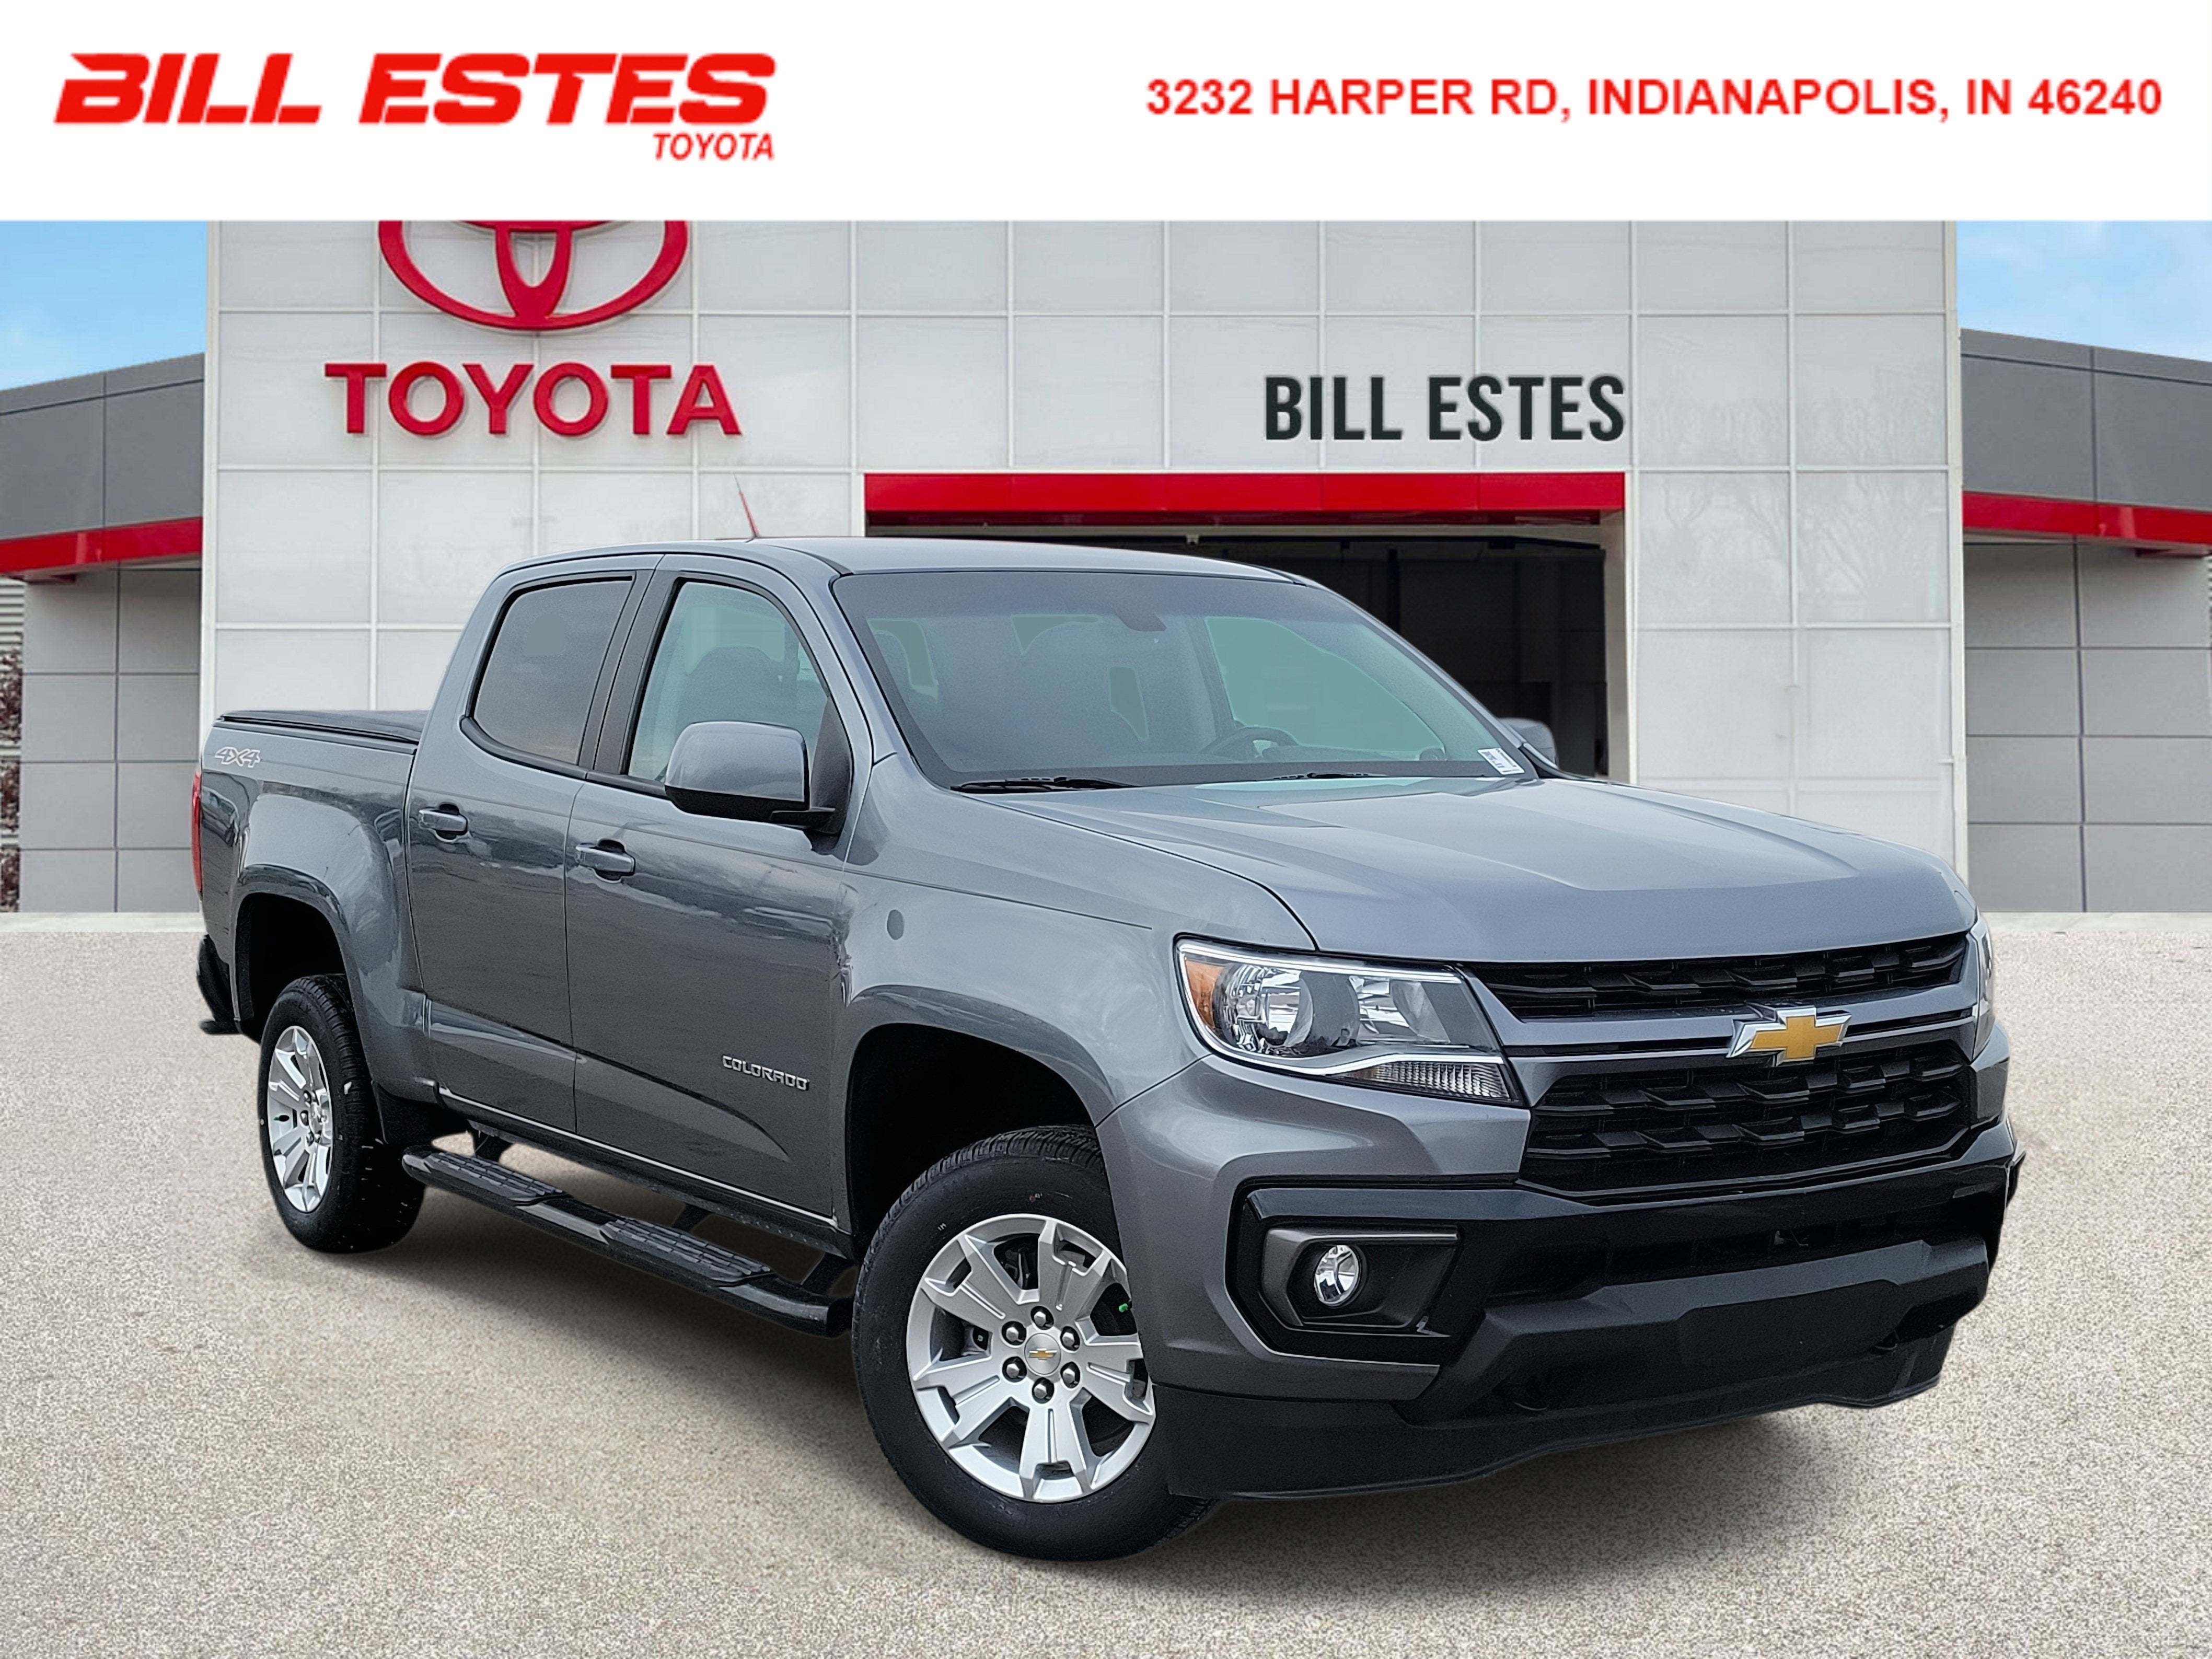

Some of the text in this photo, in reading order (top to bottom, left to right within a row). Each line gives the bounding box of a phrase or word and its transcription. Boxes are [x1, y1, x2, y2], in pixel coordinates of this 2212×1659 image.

[325, 361, 741, 436] TOYOTA
[1265, 375, 1624, 442] BILL ESTES
[722, 1054, 809, 1091] COLORADO
